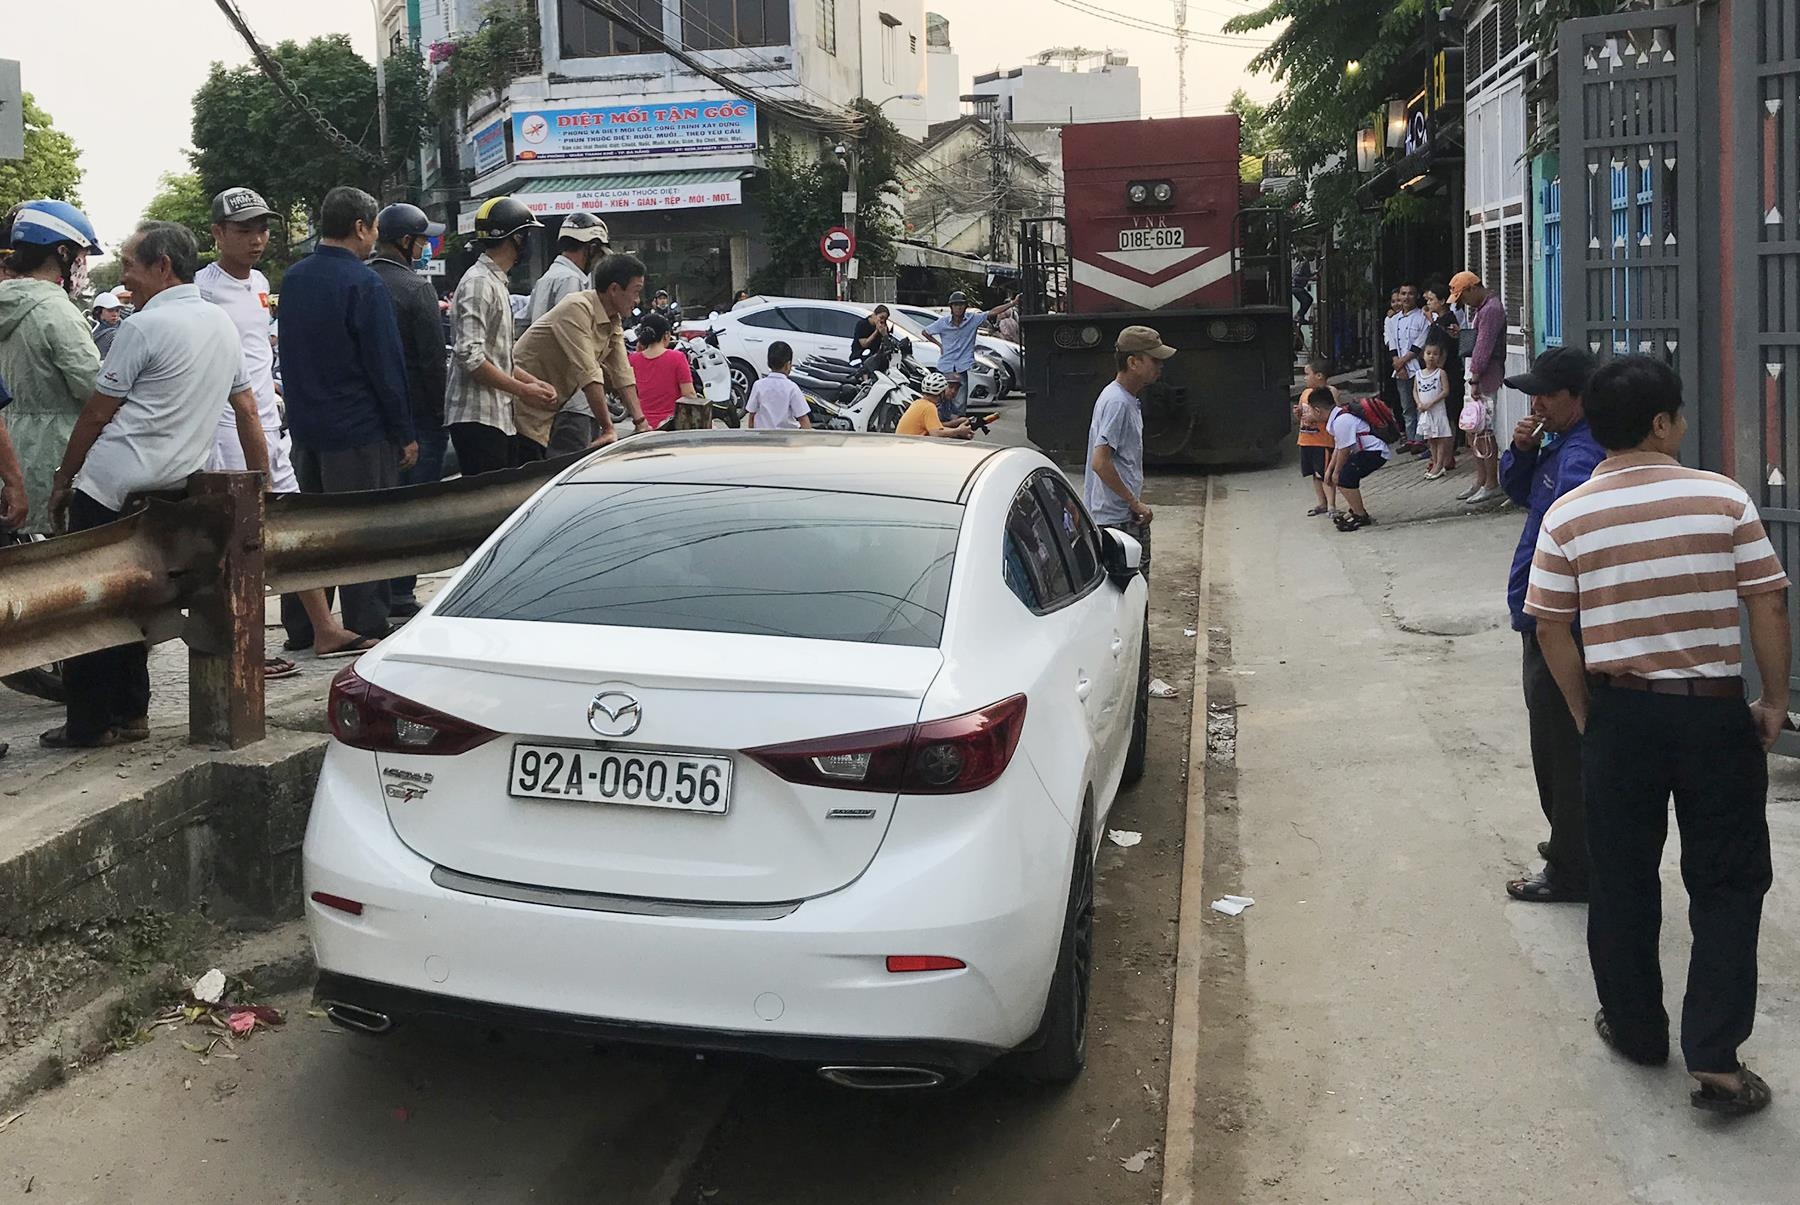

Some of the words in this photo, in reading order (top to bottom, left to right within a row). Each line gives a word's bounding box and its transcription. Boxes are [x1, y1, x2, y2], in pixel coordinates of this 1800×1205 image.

[557, 111, 604, 128] DIỆT
[611, 106, 648, 123] MỐI
[654, 106, 698, 122] TẬN
[704, 101, 749, 118] GỐC
[1121, 229, 1182, 248] D18E-602
[518, 750, 722, 806] 92A-060.56
